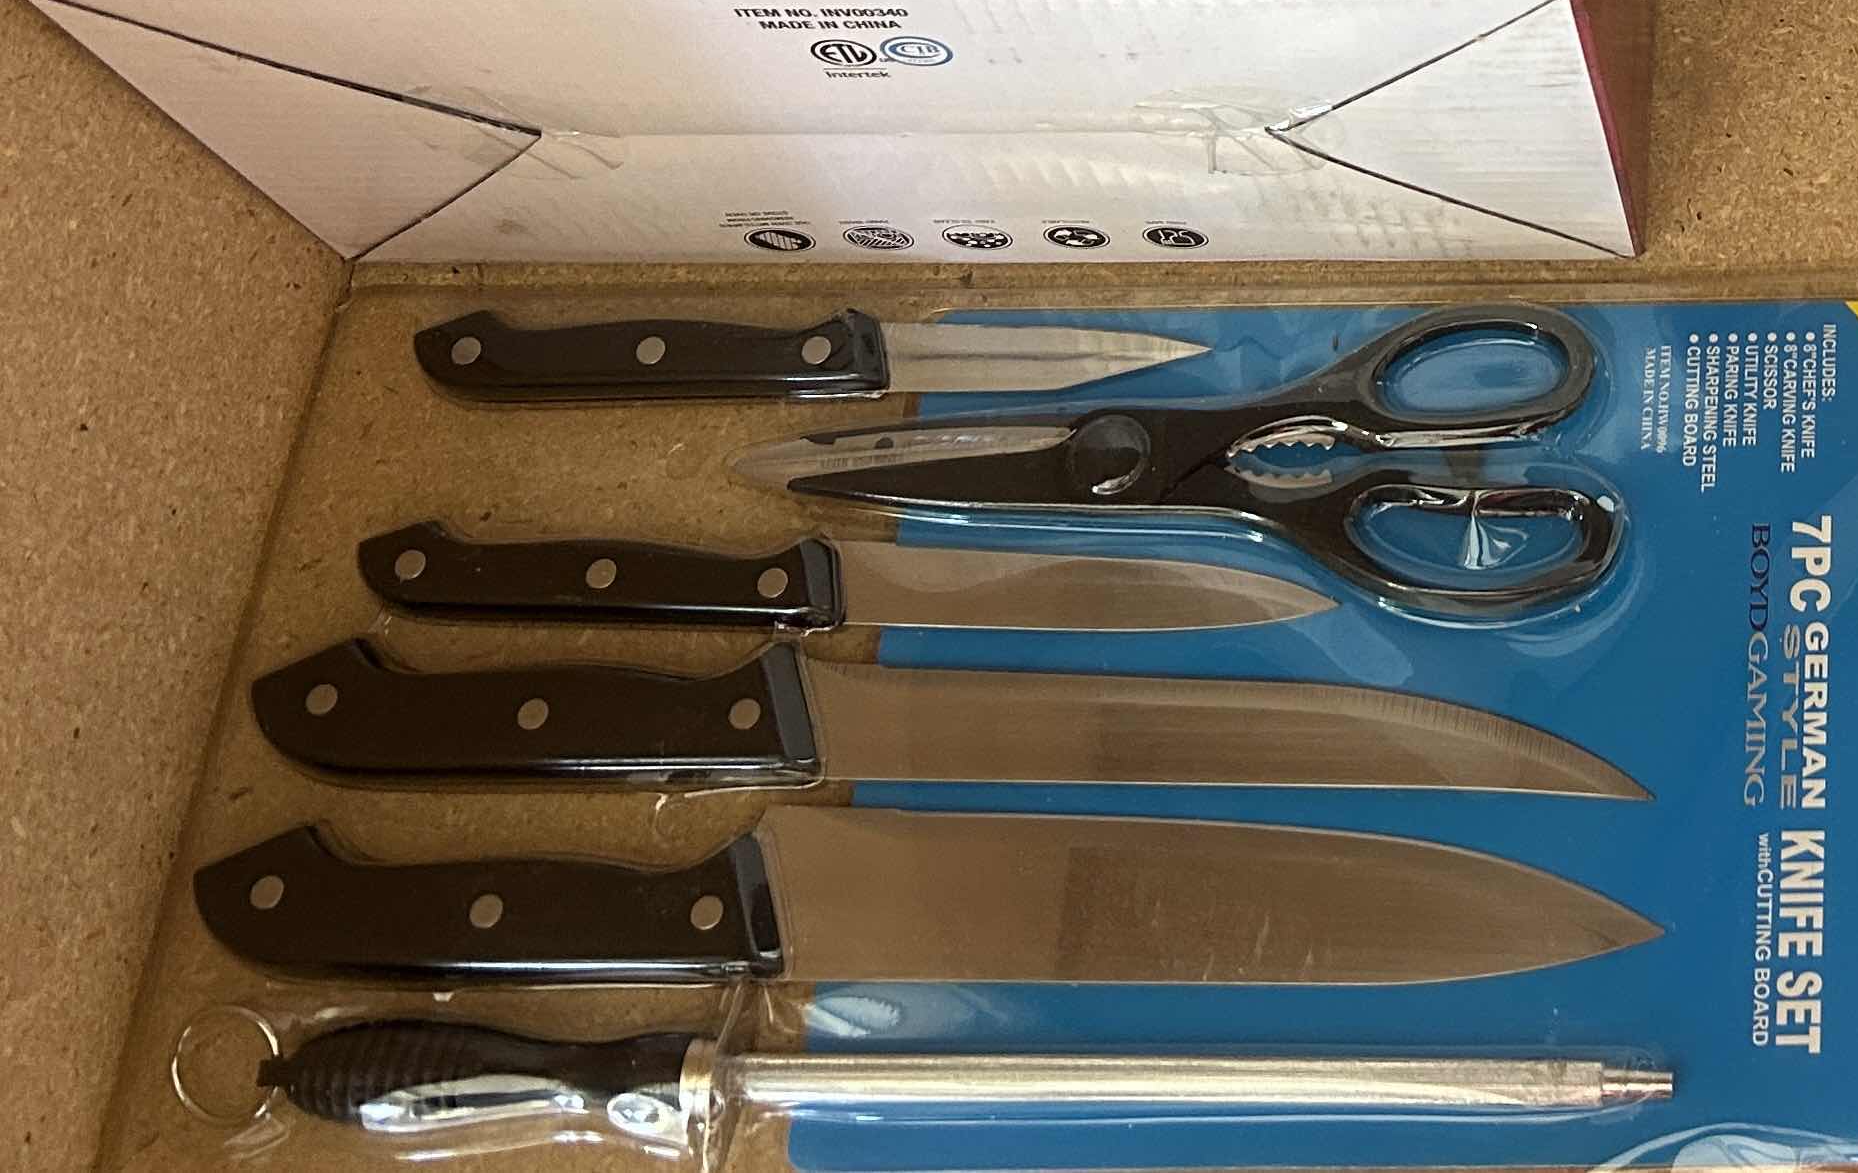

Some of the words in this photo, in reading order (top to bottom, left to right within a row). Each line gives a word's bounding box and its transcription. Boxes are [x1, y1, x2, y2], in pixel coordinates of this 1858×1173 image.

[733, 8, 782, 18] ITEM
[784, 8, 818, 18] NO.
[758, 20, 816, 29] MADE
[818, 20, 839, 29] IN
[842, 20, 903, 30] CHINA
[1686, 345, 1701, 409] CUTTING
[1725, 345, 1739, 400] PARING
[1744, 345, 1759, 398] UTILITY
[1764, 344, 1777, 409] SCISSOR
[1822, 323, 1836, 401] INCLUDES:
[1704, 345, 1720, 440] SHARPENING
[1683, 412, 1698, 466] BOARD
[1723, 404, 1737, 447] KNIFE
[1743, 402, 1757, 446] KNIFE
[1781, 428, 1795, 472] KNIFE
[1801, 414, 1815, 458] KNIFE
[1702, 443, 1716, 493] STEEL
[1789, 515, 1832, 612] 7PC
[1780, 624, 1801, 811] STYLE
[1801, 621, 1829, 809] GERMAN
[1777, 830, 1825, 958] KNIFE
[1752, 967, 1771, 1047] BOARD
[1775, 971, 1823, 1054] SET
